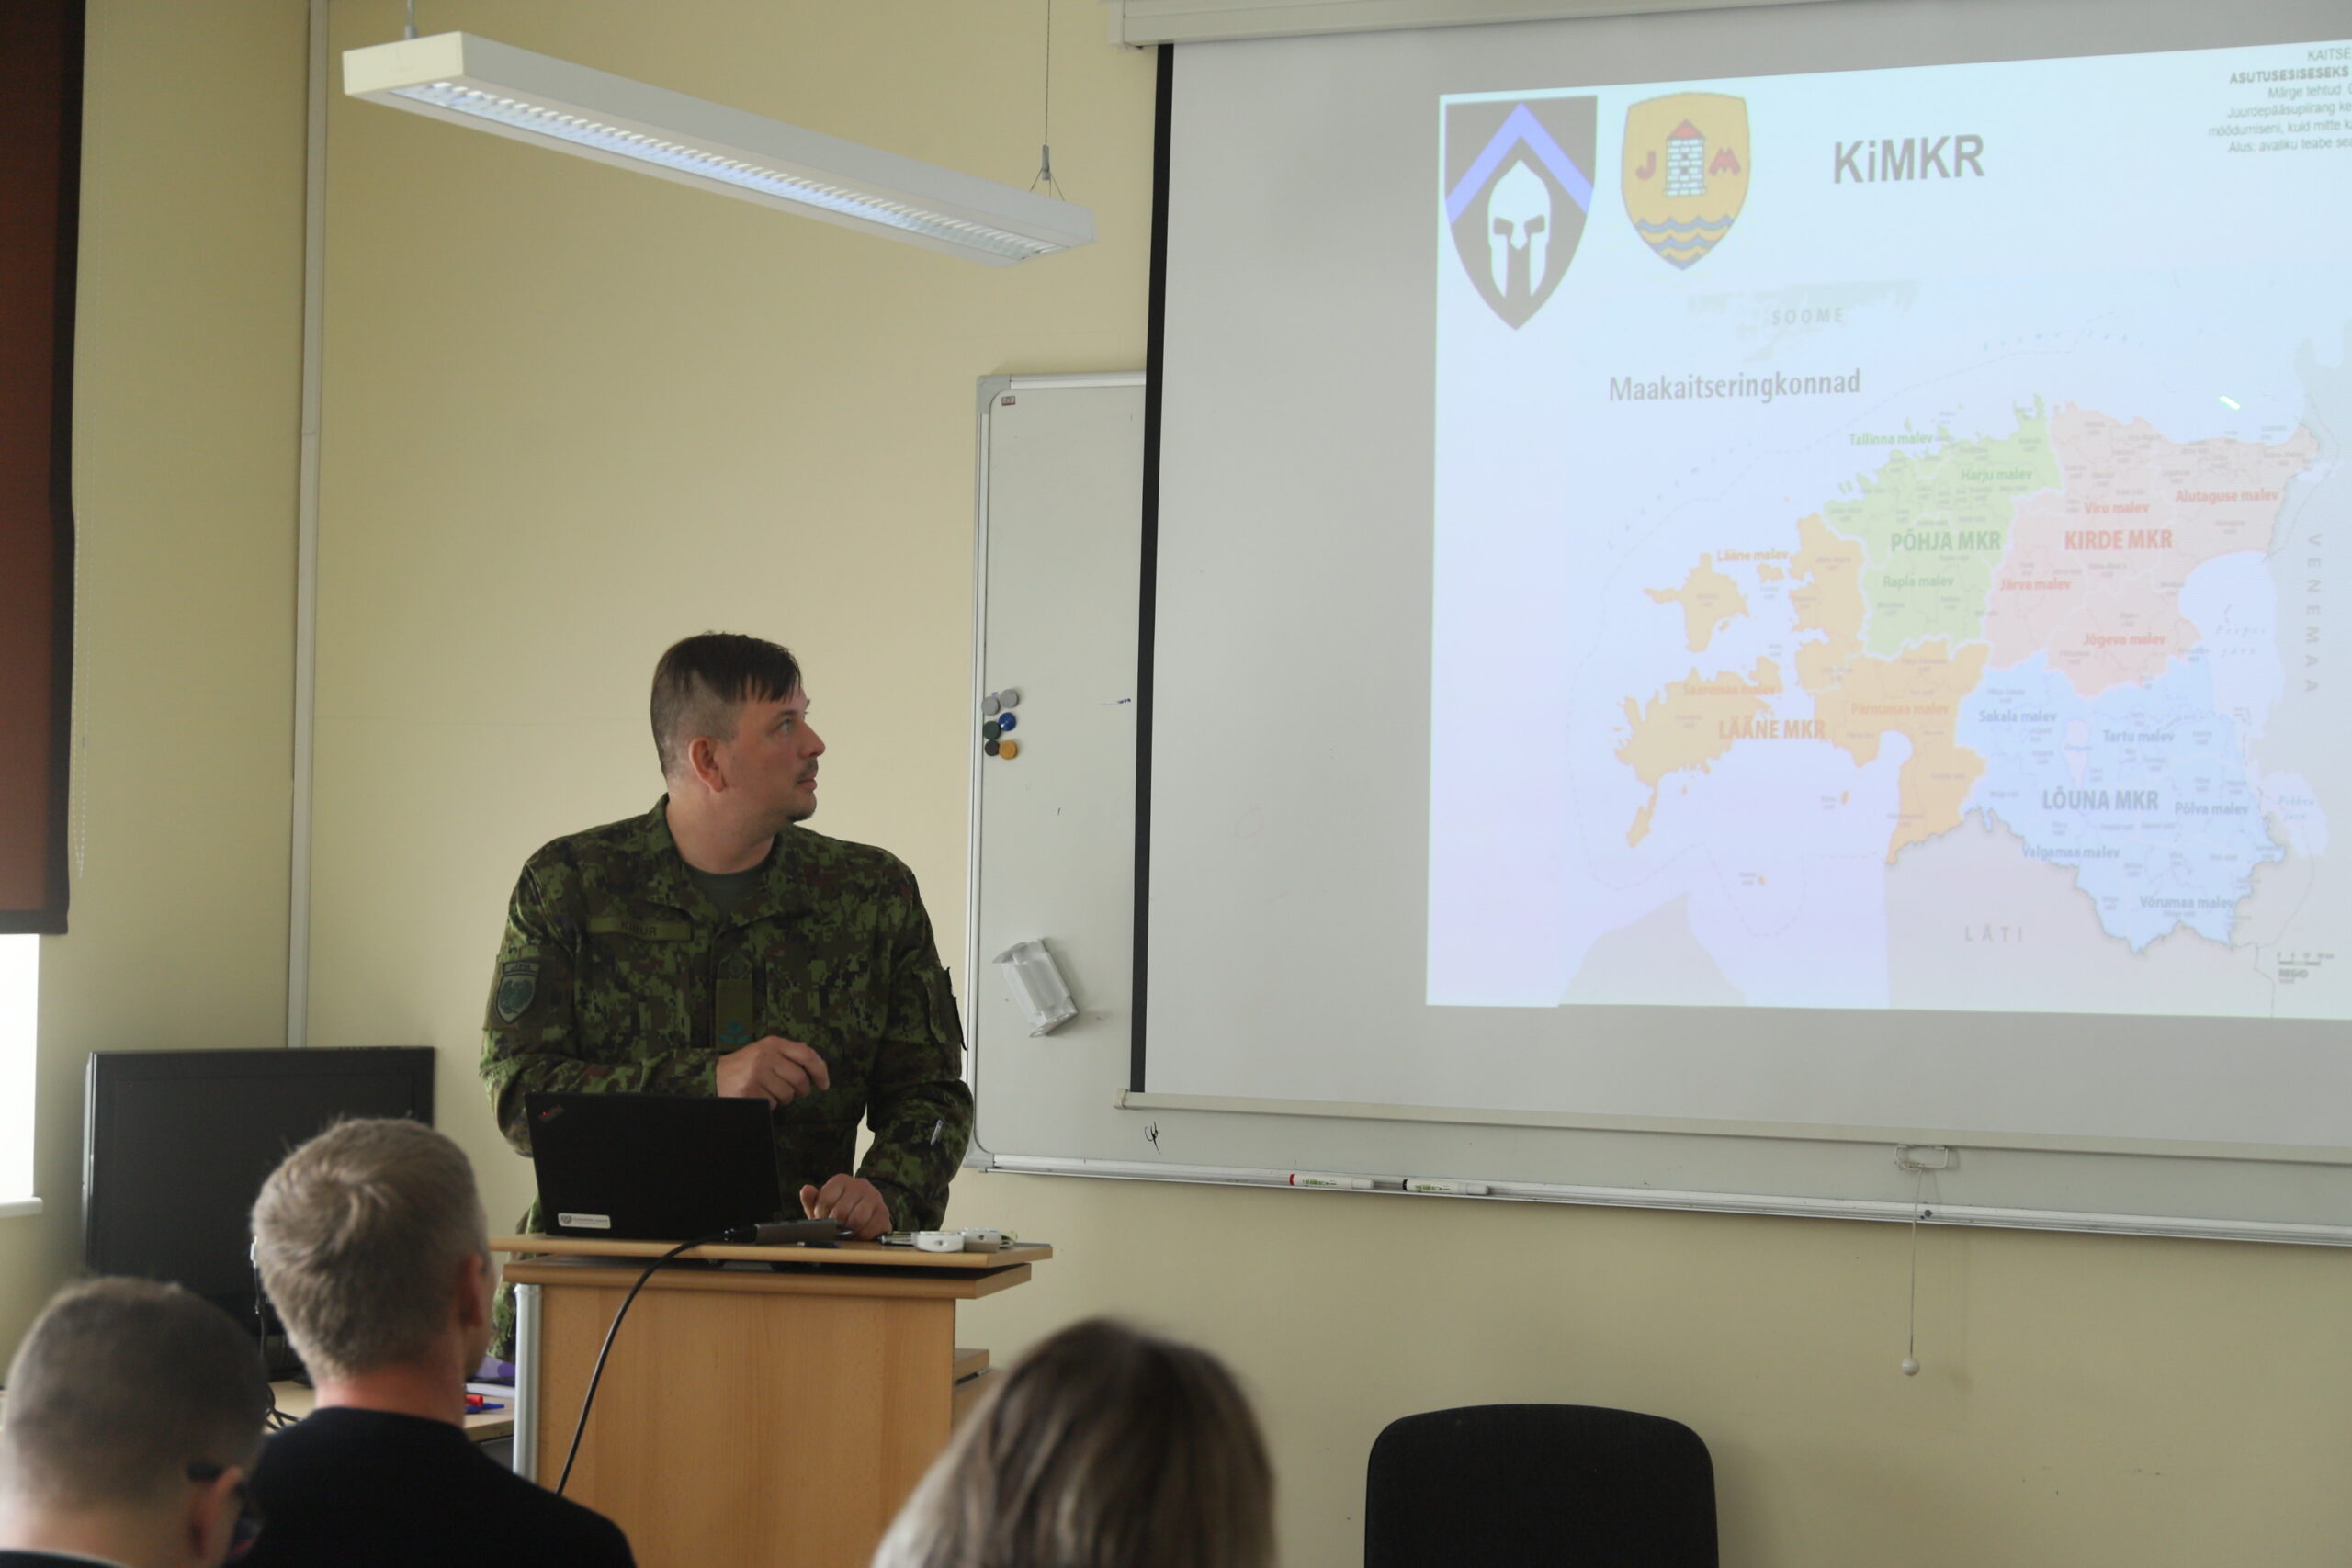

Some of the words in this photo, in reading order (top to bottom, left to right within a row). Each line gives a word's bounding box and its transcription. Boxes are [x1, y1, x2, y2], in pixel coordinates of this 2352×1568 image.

[2230, 66, 2349, 84] ASUTUSESISESEKS
[1834, 134, 1985, 185] KiMKR
[1770, 307, 1845, 326] SOOME
[1608, 367, 1862, 405] Maakaitseringkonnad
[1849, 433, 1895, 446] Tallinna
[1897, 430, 1934, 445] malev
[1961, 468, 1995, 484] Harju
[1996, 466, 2033, 480] malev
[2175, 489, 2238, 504] Alutaguse
[2241, 487, 2278, 502] malev
[2084, 502, 2109, 515] Viru
[2112, 500, 2149, 514] malev
[1891, 527, 1953, 551] PÕHJA
[1958, 530, 2002, 551] MKR
[2064, 530, 2123, 551] KIRDE
[2128, 528, 2174, 549] MKR
[1716, 548, 1751, 563] Lääne
[1753, 547, 1789, 562] malev
[1883, 575, 1916, 591] Rapla
[1917, 573, 1955, 588] malev
[1999, 579, 2033, 592] Järva
[2035, 576, 2073, 591] malev
[2305, 534, 2324, 692] VENEMAA
[2083, 633, 2127, 649] Jõgeva
[2129, 632, 2166, 646] malev
[1913, 700, 1950, 716] malev
[1978, 709, 2018, 723] Sakala
[2020, 709, 2058, 723] malev
[1718, 716, 1780, 739] LÄÄNE
[1783, 720, 1826, 739] MKR
[2102, 729, 2135, 742] Tartu
[2138, 728, 2176, 742] malev
[2042, 785, 2110, 810] LÕUNA
[2115, 789, 2159, 811] MKR
[2174, 801, 2209, 816] Põlva
[2211, 801, 2250, 816] malev
[2021, 844, 2081, 861] Valgamaa
[2083, 844, 2120, 859] malev
[2139, 896, 2195, 910] Võrumaa
[2197, 896, 2235, 909] malev
[1964, 921, 2024, 942] LÄTI
